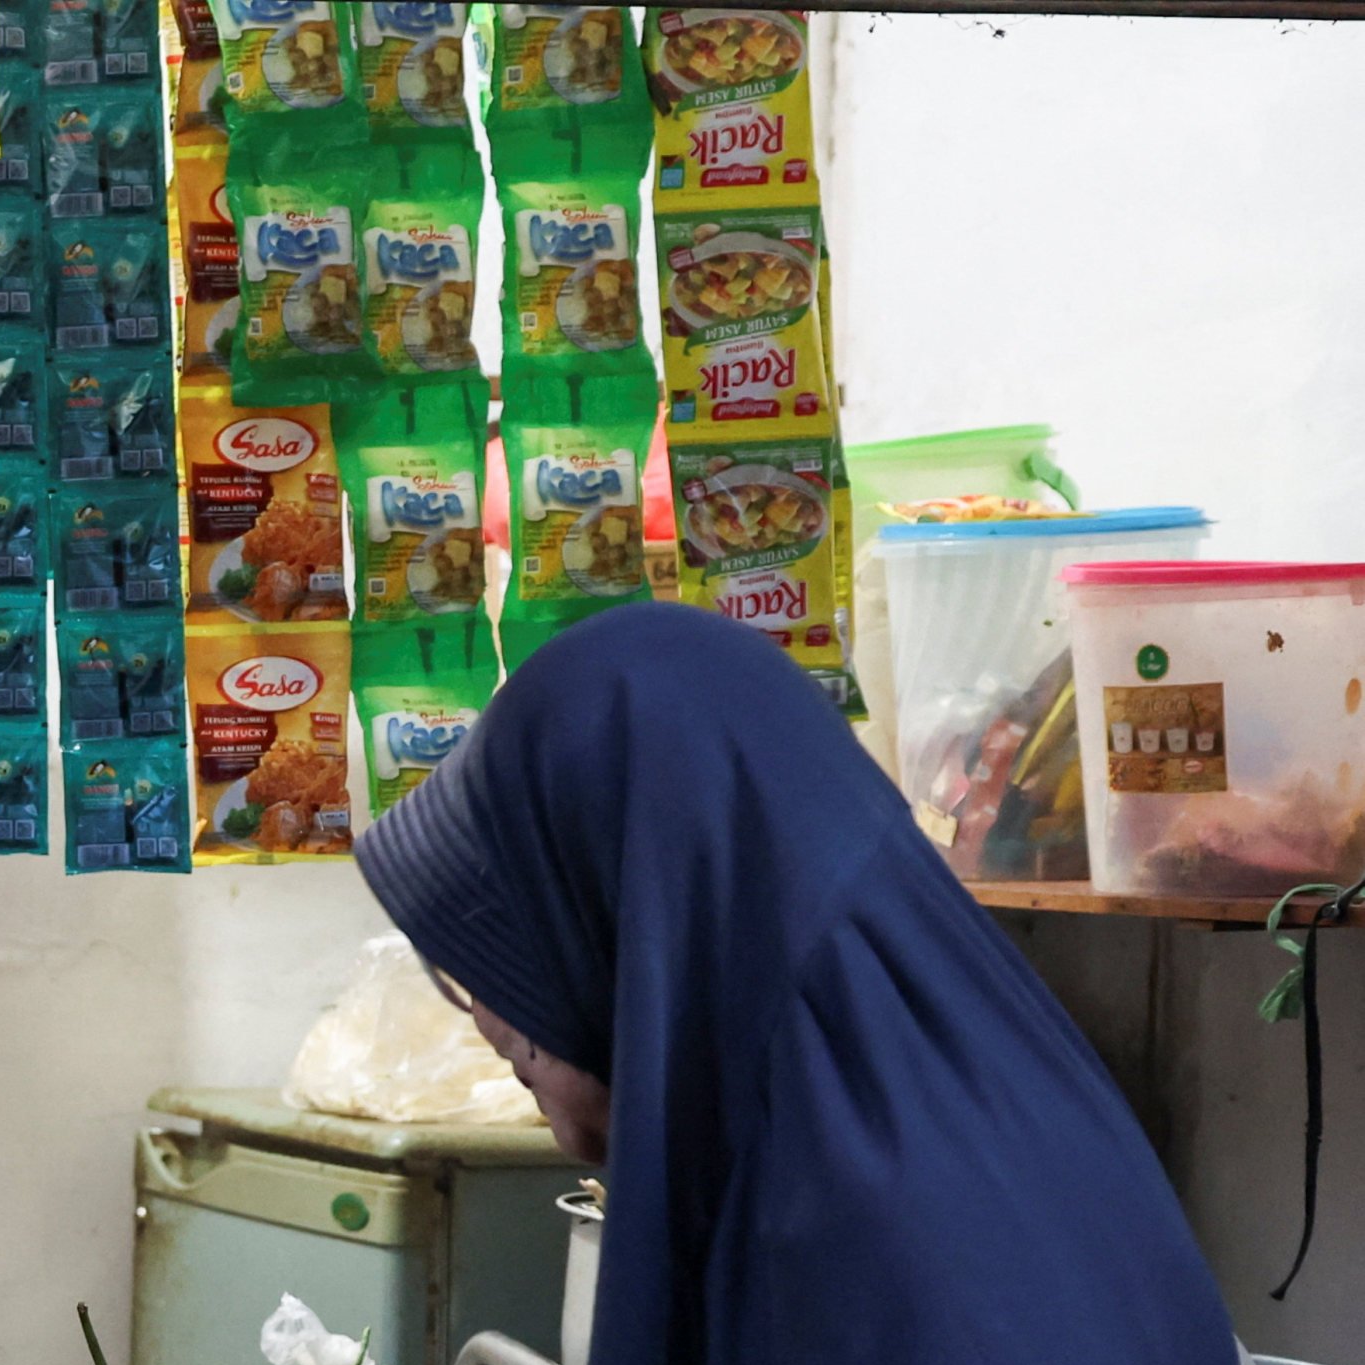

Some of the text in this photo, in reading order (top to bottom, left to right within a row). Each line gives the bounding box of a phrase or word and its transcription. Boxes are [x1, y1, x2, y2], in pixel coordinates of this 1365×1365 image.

[695, 79, 776, 106] SAYUR ASEM
[689, 114, 784, 166] Racik
[206, 247, 239, 258] KENTU
[699, 348, 796, 399] Racik
[230, 424, 304, 460] Sasa
[209, 488, 264, 498] KENTUCKY
[717, 580, 808, 621] Racik
[234, 664, 309, 700] Sasa
[213, 729, 268, 738] KENTUCKY
